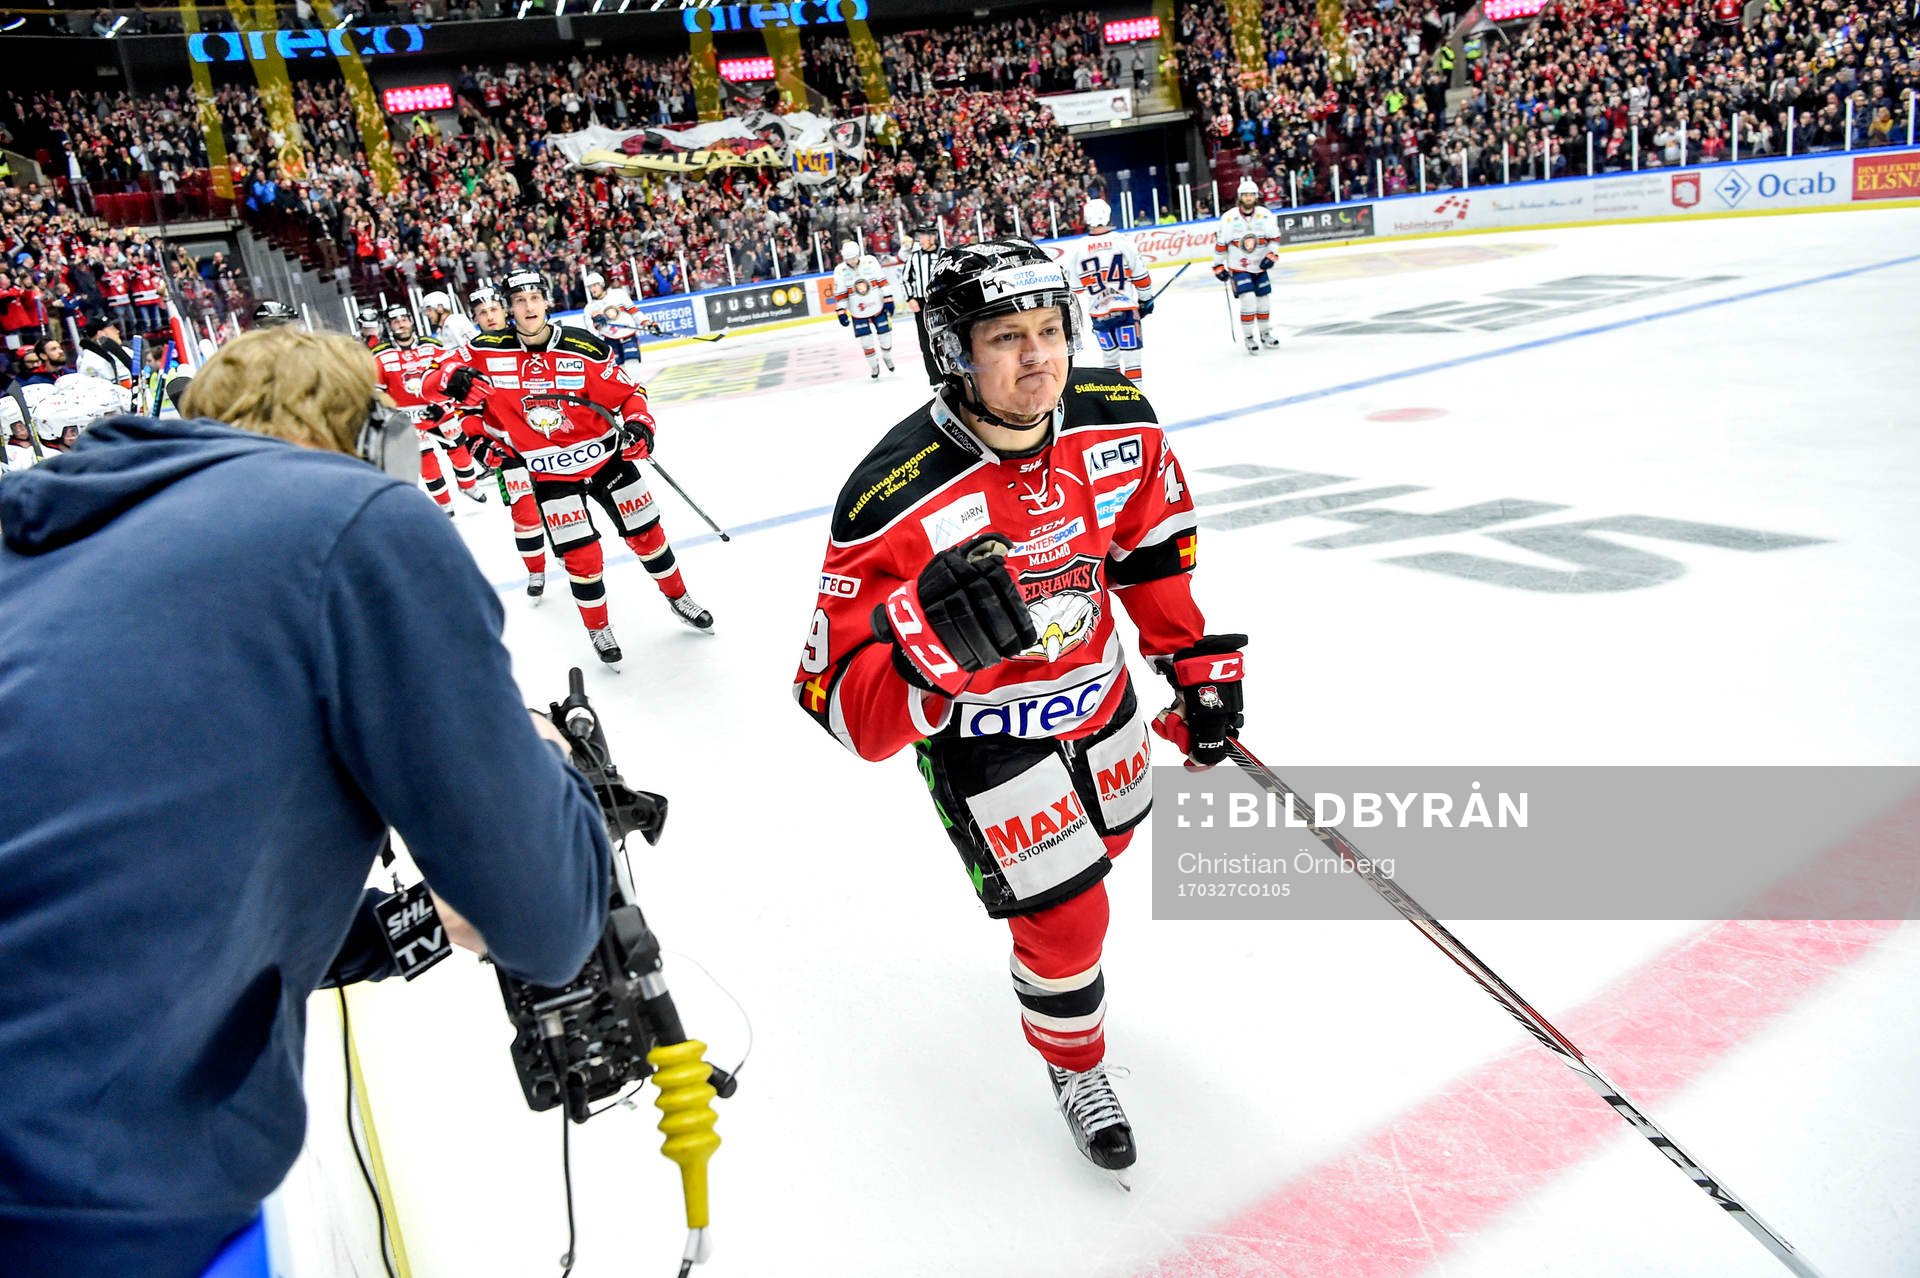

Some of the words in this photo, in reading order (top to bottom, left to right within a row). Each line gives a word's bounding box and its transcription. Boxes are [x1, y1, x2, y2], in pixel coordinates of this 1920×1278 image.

[683, 0, 868, 33] areco
[188, 24, 426, 63] areco
[1758, 171, 1837, 198] Ocab
[1394, 218, 1454, 232] Holmbergs
[1013, 270, 1036, 279] OTTO
[1016, 275, 1063, 287] MAGNUSSON
[1081, 253, 1128, 296] 34
[530, 443, 603, 473] areco
[1020, 458, 1044, 473] SHL
[1089, 439, 1140, 477] APQ
[848, 440, 941, 521] Ställningsbyggarna
[908, 468, 921, 483] AB
[546, 509, 588, 528] MAXI
[618, 491, 653, 515] MAXI
[1025, 521, 1080, 552] INTERSPORT
[1030, 516, 1066, 537] CCM
[819, 575, 855, 594] T80
[1022, 563, 1091, 601] EDHAWKS
[801, 608, 830, 675] 9
[970, 683, 1102, 737] arec
[1198, 740, 1224, 749] CCM
[1096, 739, 1150, 795] MAX
[1102, 793, 1118, 802] ICA
[984, 790, 1084, 859] MAXI
[1001, 858, 1018, 869] ICA
[1018, 815, 1089, 862] STORMARKNAD
[386, 897, 434, 937] SHL
[395, 925, 443, 967] TV
